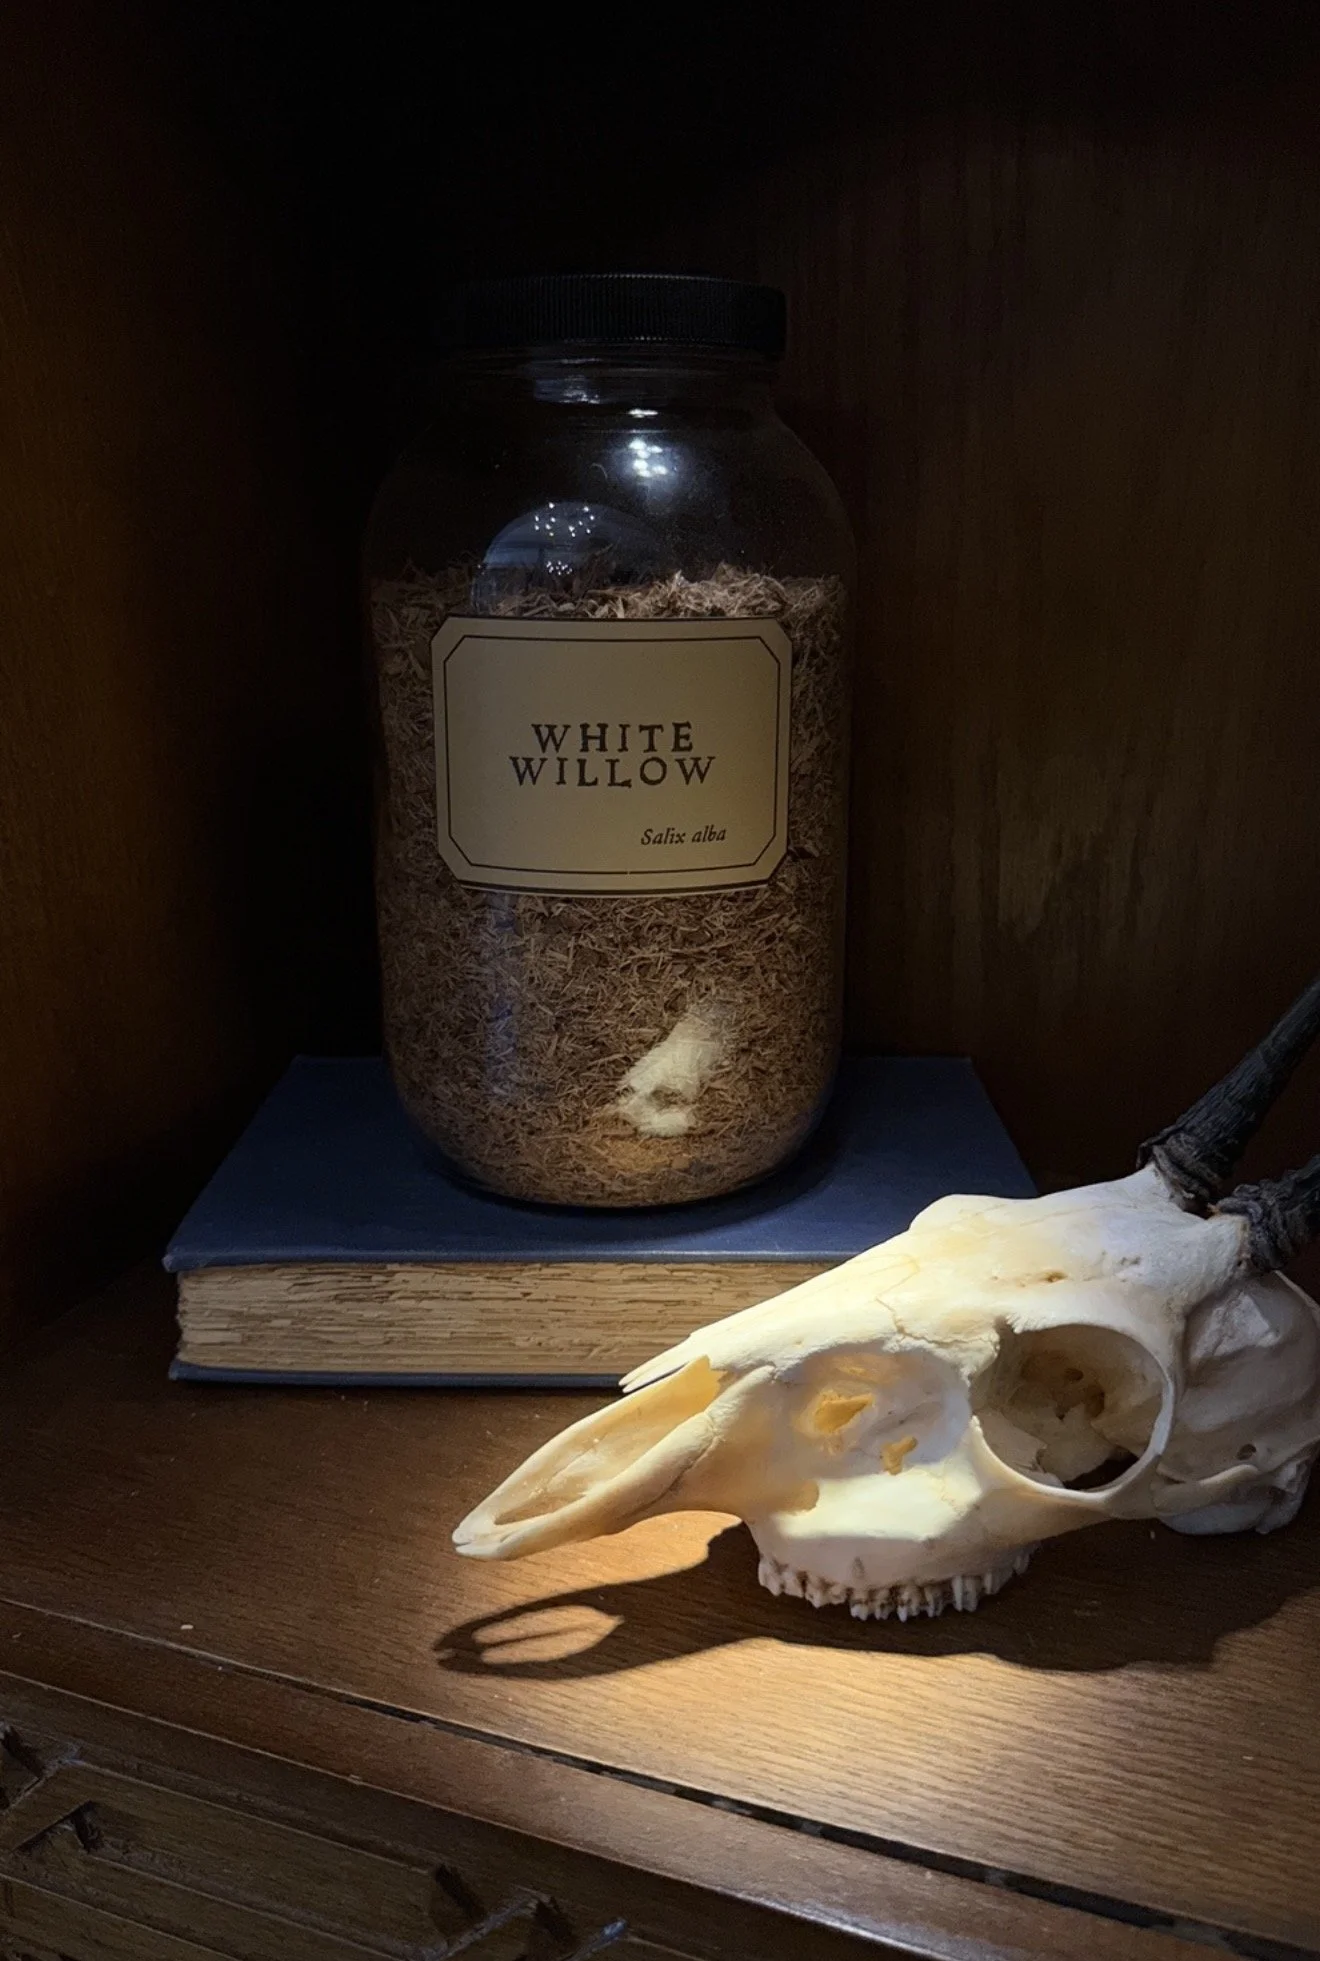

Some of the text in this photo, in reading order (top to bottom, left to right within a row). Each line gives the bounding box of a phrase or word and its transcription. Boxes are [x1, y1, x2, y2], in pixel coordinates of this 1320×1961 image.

[530, 720, 694, 753] WHITE
[508, 756, 716, 788] WILLOW
[640, 824, 727, 846] Salix alba
